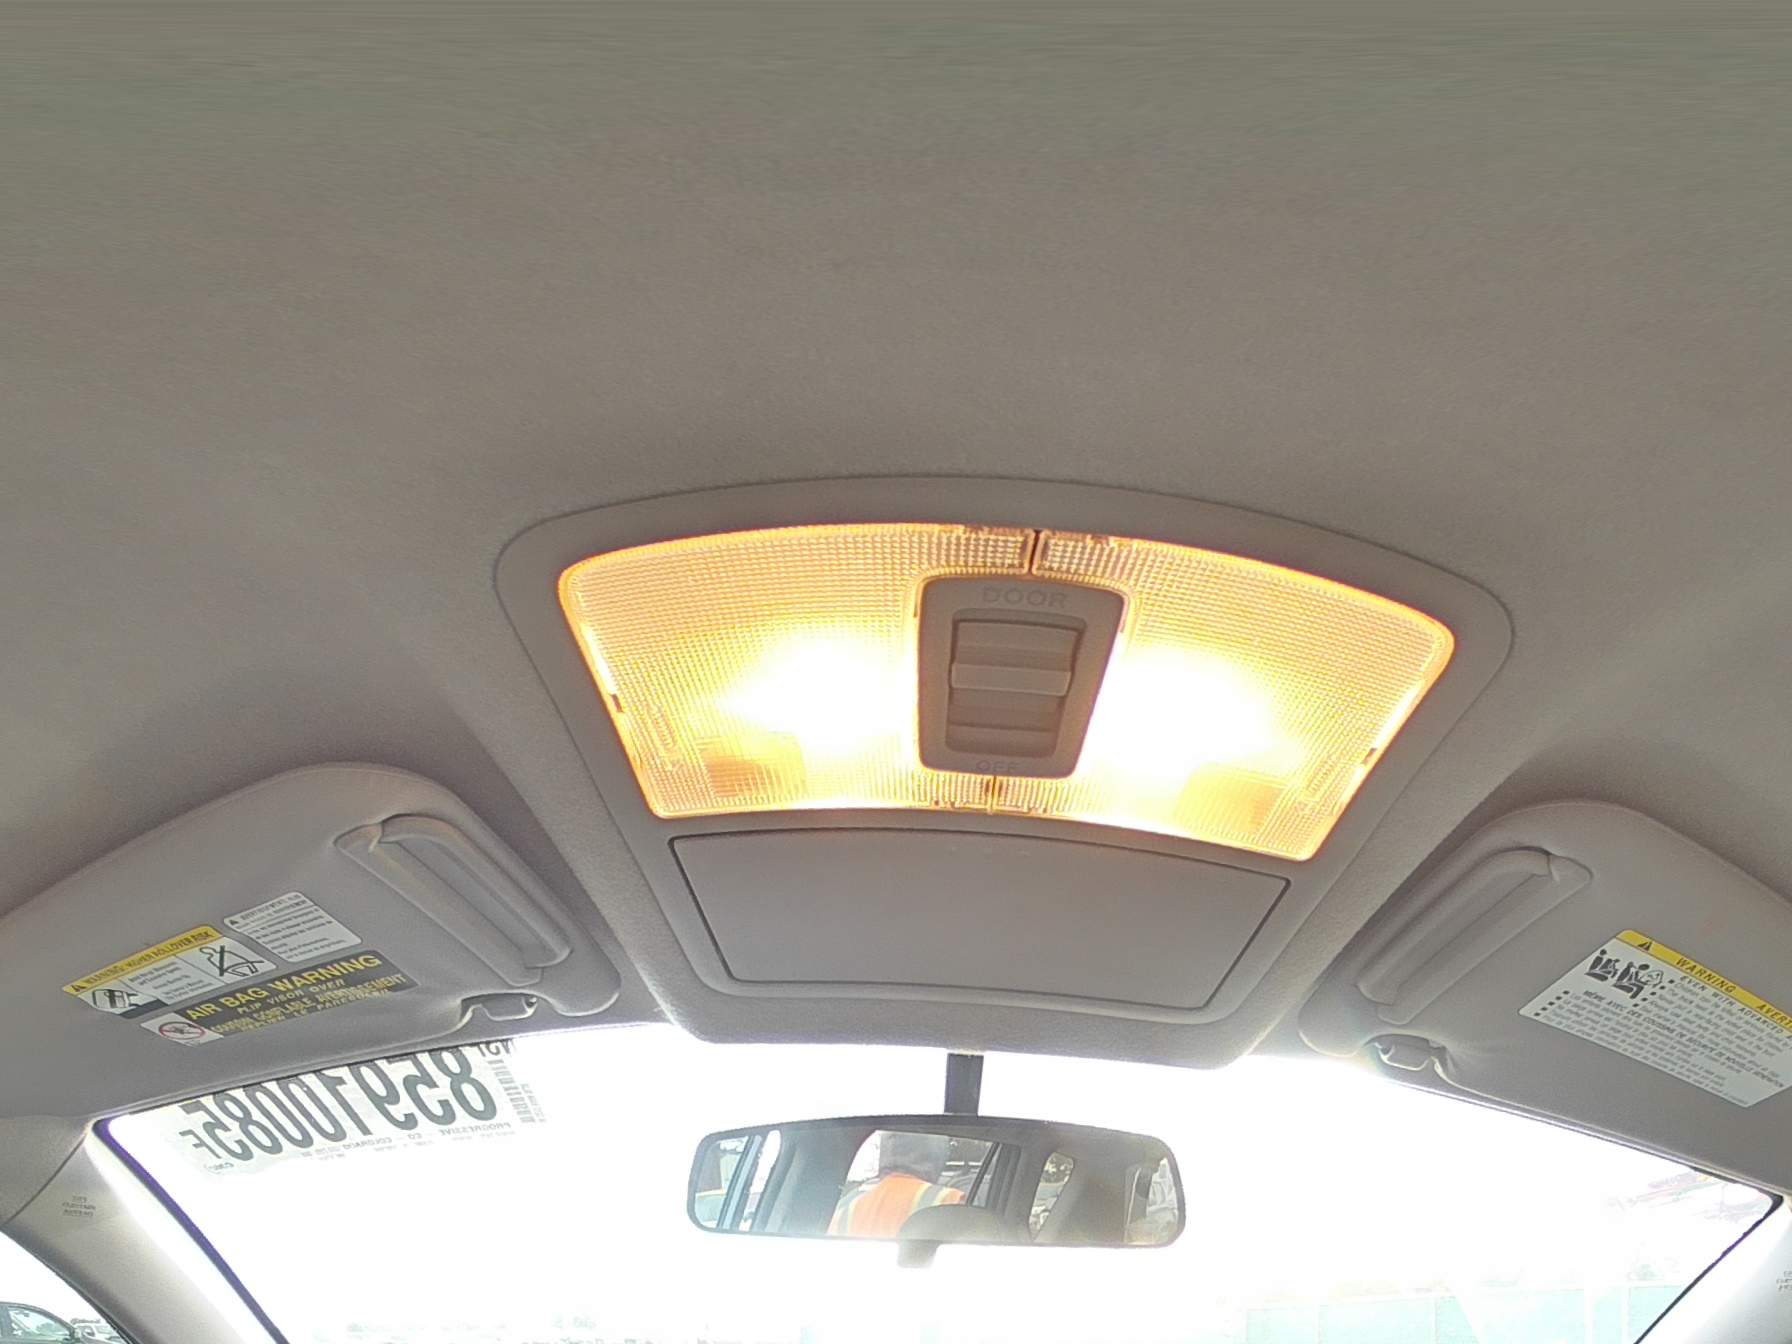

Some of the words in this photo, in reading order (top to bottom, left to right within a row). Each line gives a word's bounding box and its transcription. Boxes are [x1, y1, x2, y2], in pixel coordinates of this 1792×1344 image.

[982, 586, 1068, 608] DOOR
[977, 760, 1020, 772] OFF
[193, 931, 215, 944] RISK
[185, 1002, 221, 1020] AIR
[219, 988, 270, 1007] BAG
[268, 955, 382, 992] WARNING
[316, 973, 408, 1002] AVERTISSEMENT
[1675, 957, 1737, 994] WARNING
[237, 1002, 262, 1015] FLIP
[268, 990, 304, 1006] VISOR
[310, 979, 346, 993] OVER
[1679, 975, 1707, 991] EVEN
[1712, 991, 1736, 1006] WITH
[1739, 1007, 1783, 1034] ADVANCED
